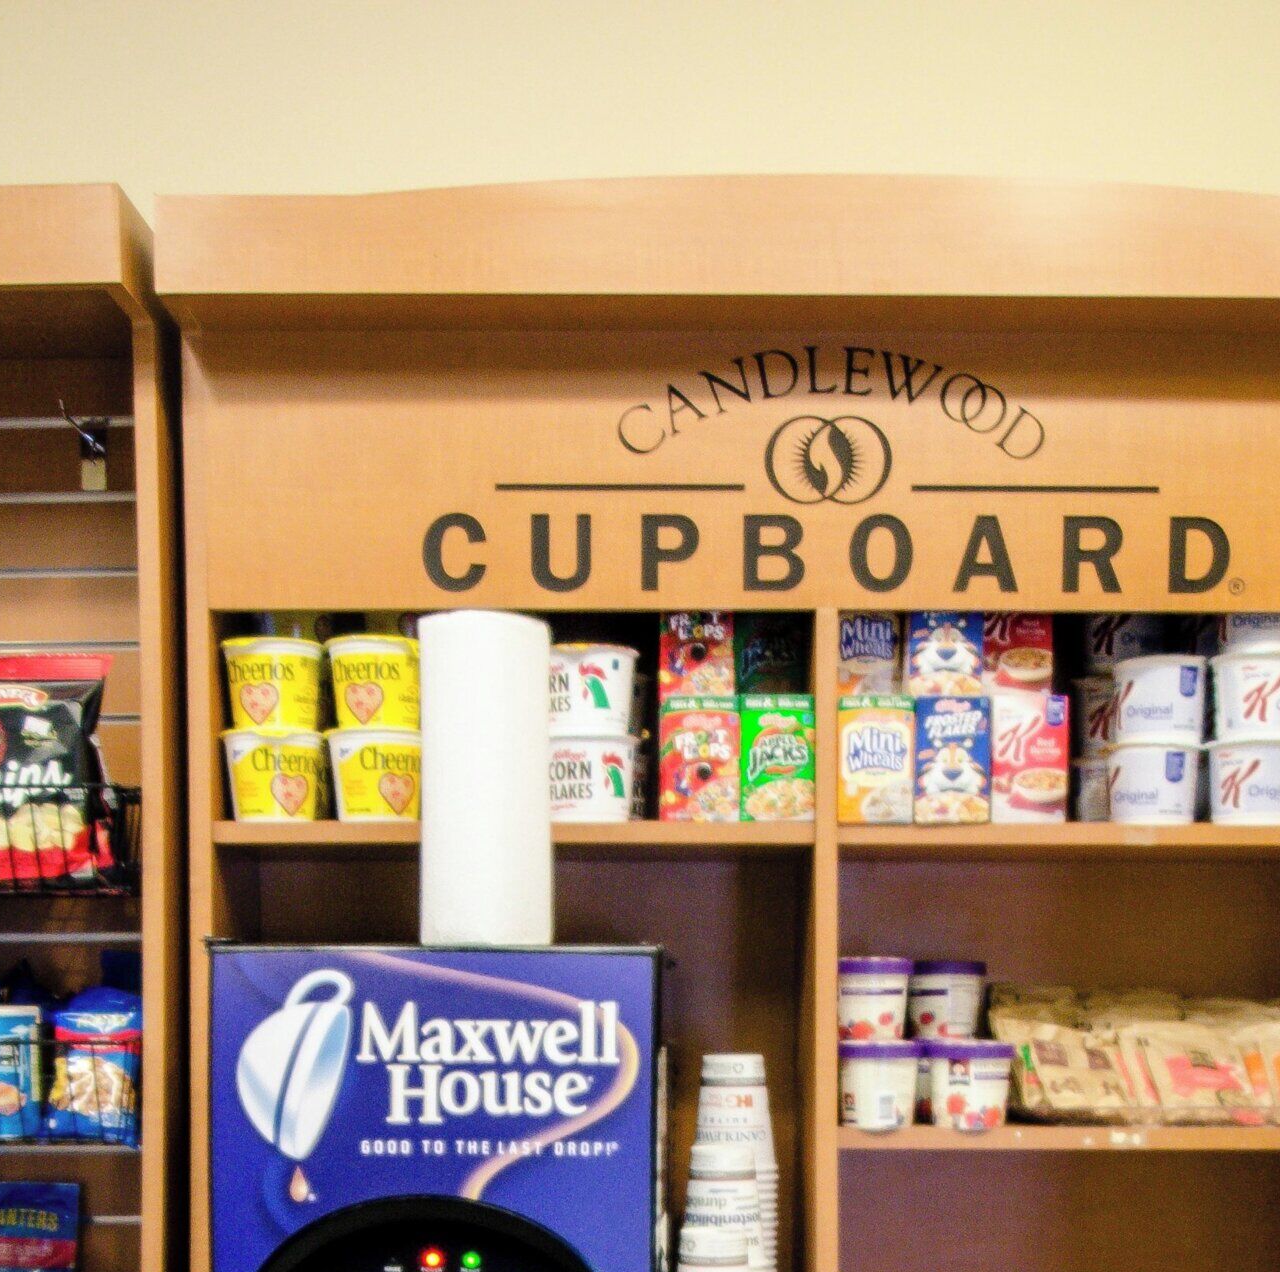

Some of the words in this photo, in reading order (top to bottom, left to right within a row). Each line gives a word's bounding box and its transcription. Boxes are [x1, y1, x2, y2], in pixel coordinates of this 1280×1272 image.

[617, 345, 1047, 461] CANDLEWOOD
[421, 513, 1232, 595] CUPBOARD
[1125, 701, 1174, 721] Original
[847, 749, 904, 773] Wheats
[848, 727, 903, 755] Mini
[355, 1000, 620, 1065] Maxwell
[386, 1063, 588, 1125] House
[360, 1139, 411, 1156] GOOD
[422, 1140, 445, 1156] TO
[455, 1140, 490, 1156] THE
[497, 1140, 543, 1156] LAST
